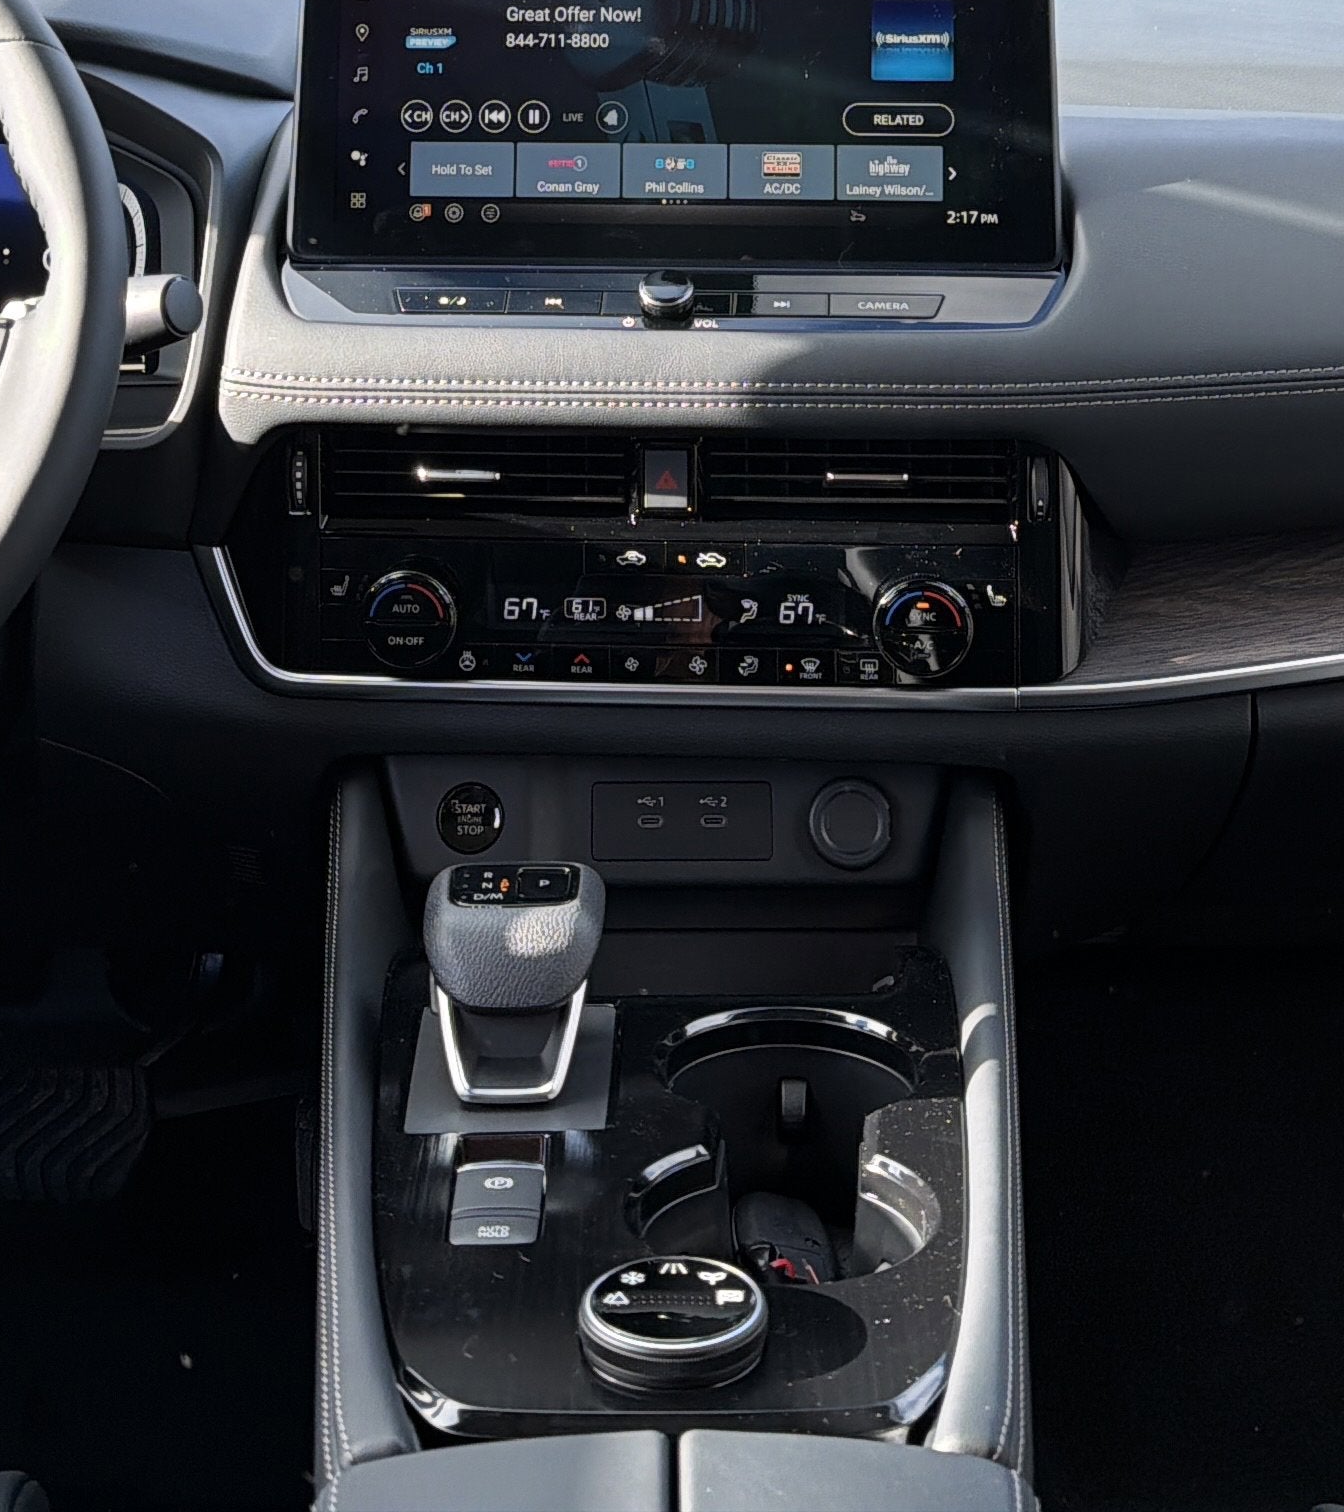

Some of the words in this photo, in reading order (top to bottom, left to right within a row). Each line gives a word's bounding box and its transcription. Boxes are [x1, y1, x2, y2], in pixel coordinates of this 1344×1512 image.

[506, 7, 551, 22] Great
[555, 6, 597, 22] Offer
[600, 6, 642, 23] Now!
[506, 33, 610, 48] 844-711-8800
[417, 63, 434, 74] Ch
[437, 63, 443, 74] 1
[562, 112, 584, 122] LIVE
[873, 114, 924, 126] RELATED
[431, 164, 457, 175] Hold
[459, 164, 473, 175] To
[474, 164, 493, 175] Set
[869, 159, 911, 177] highway
[537, 181, 573, 193] Conan
[574, 181, 600, 195] Gray
[645, 182, 666, 193] Phil
[667, 182, 705, 194] Collins
[763, 183, 801, 195] AC/DC
[846, 184, 883, 198] Lainey
[946, 210, 979, 225] 2:17
[980, 213, 999, 225] PM
[856, 301, 910, 311] CAMERA
[693, 318, 719, 328] VOL
[787, 593, 810, 603] SYNC
[391, 604, 420, 614] AUTO
[573, 612, 597, 621] REAR
[909, 611, 937, 622] SYNC
[913, 639, 935, 650] A/C
[512, 664, 535, 673] REAR
[570, 665, 593, 674] REAR
[799, 671, 823, 680] FRONT
[859, 672, 879, 681] REAR
[658, 795, 665, 807] 1
[720, 795, 729, 807] 2
[455, 803, 487, 814] START
[457, 815, 483, 824] ENGINE
[457, 825, 485, 836] STOP
[483, 871, 494, 879] R
[538, 879, 551, 887] P
[473, 892, 504, 901] D/M
[477, 1224, 511, 1232] AUTO
